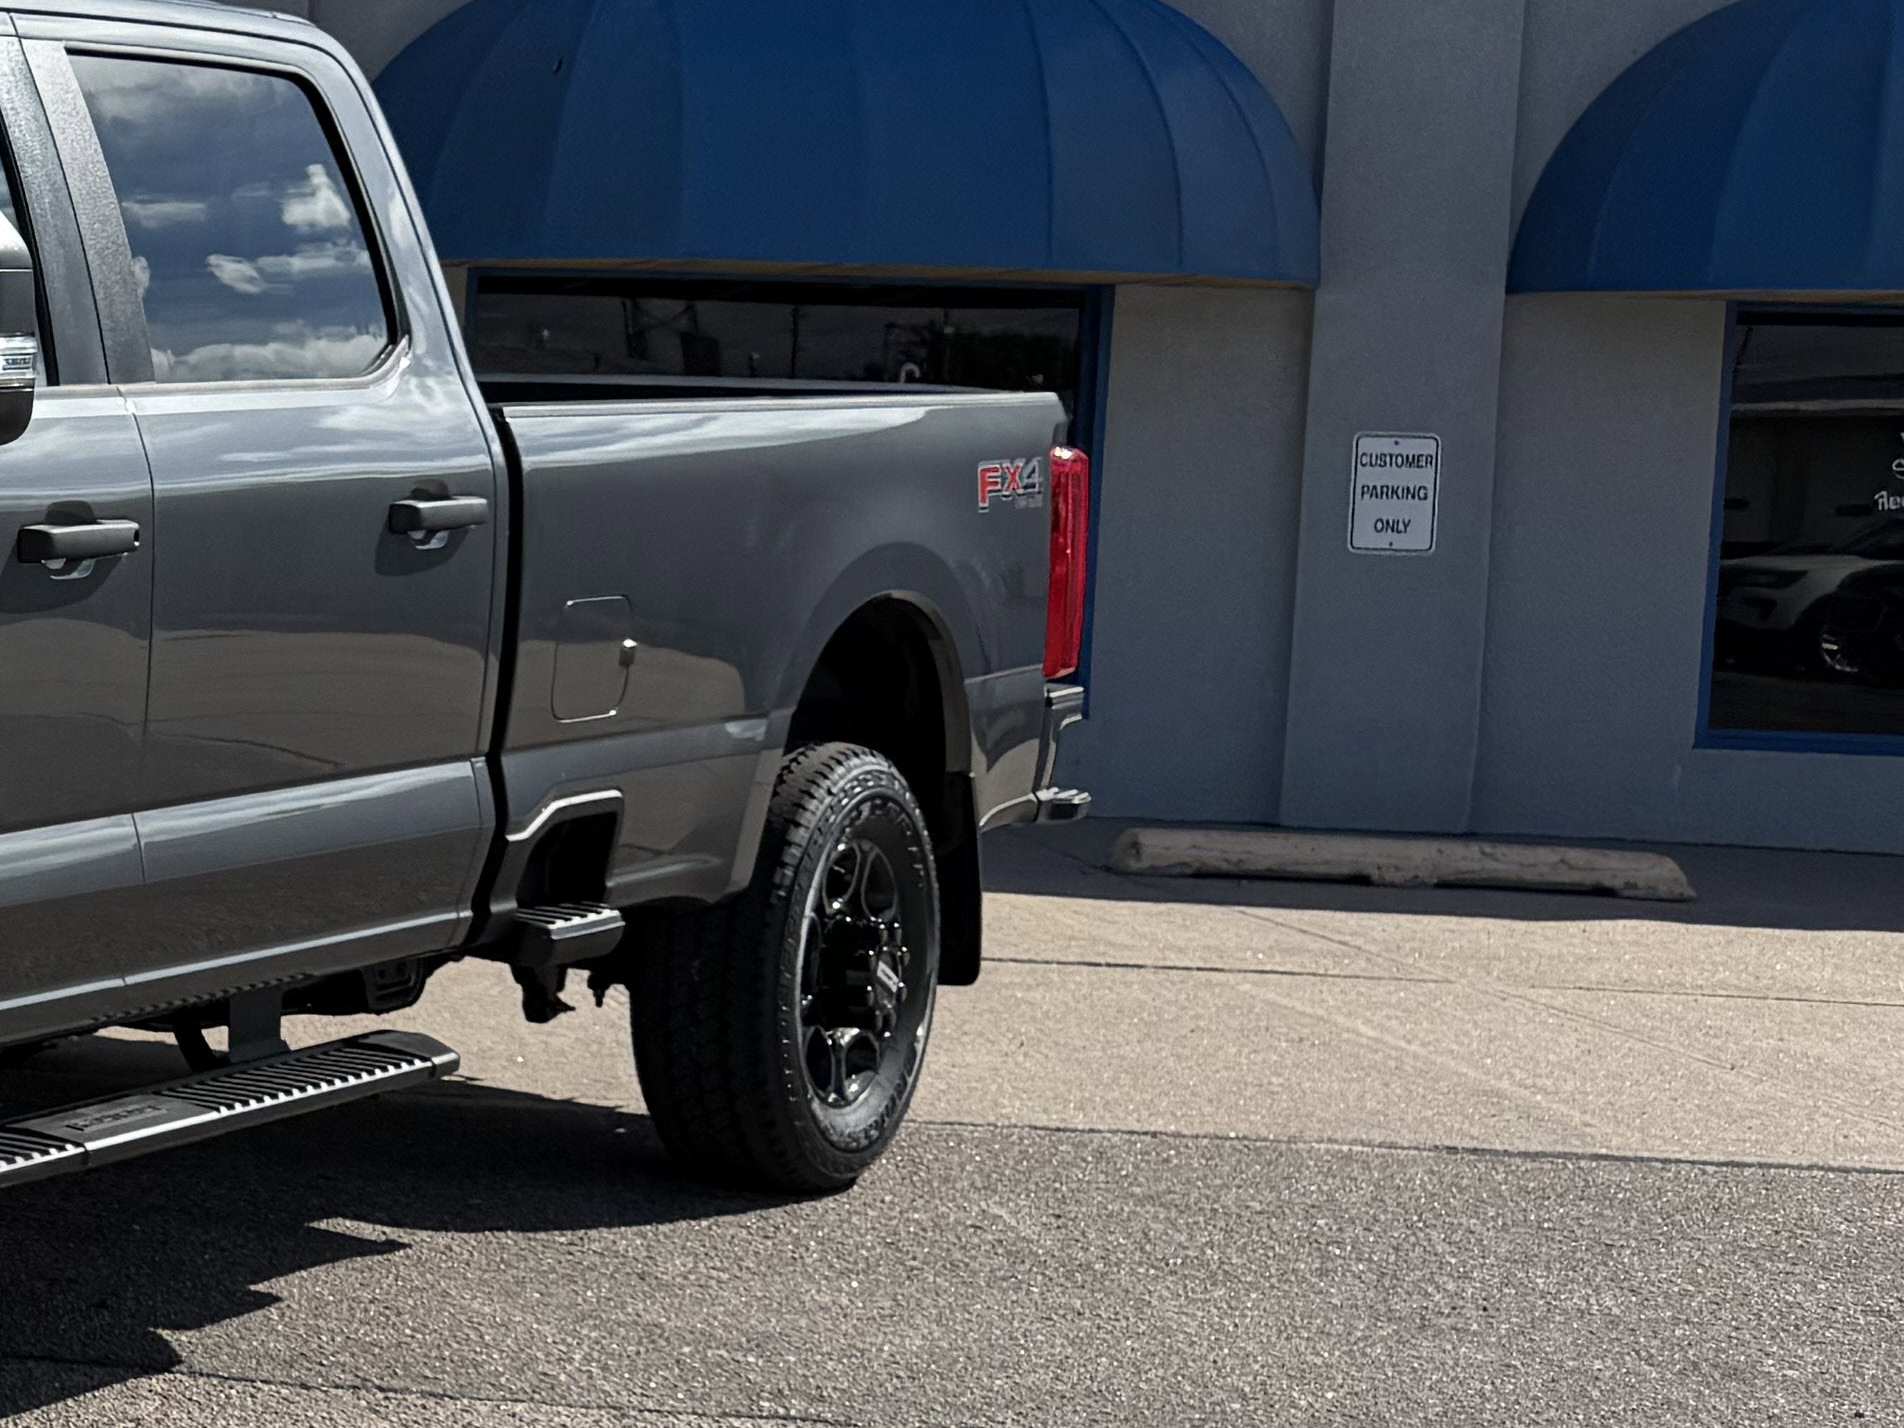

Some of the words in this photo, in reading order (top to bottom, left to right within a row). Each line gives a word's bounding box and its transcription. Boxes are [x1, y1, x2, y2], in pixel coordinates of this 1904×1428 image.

[1359, 452, 1434, 469] CUSTOMER
[978, 458, 1042, 510] FX4
[1360, 484, 1429, 501] PARKING
[1373, 518, 1412, 534] ONLY
